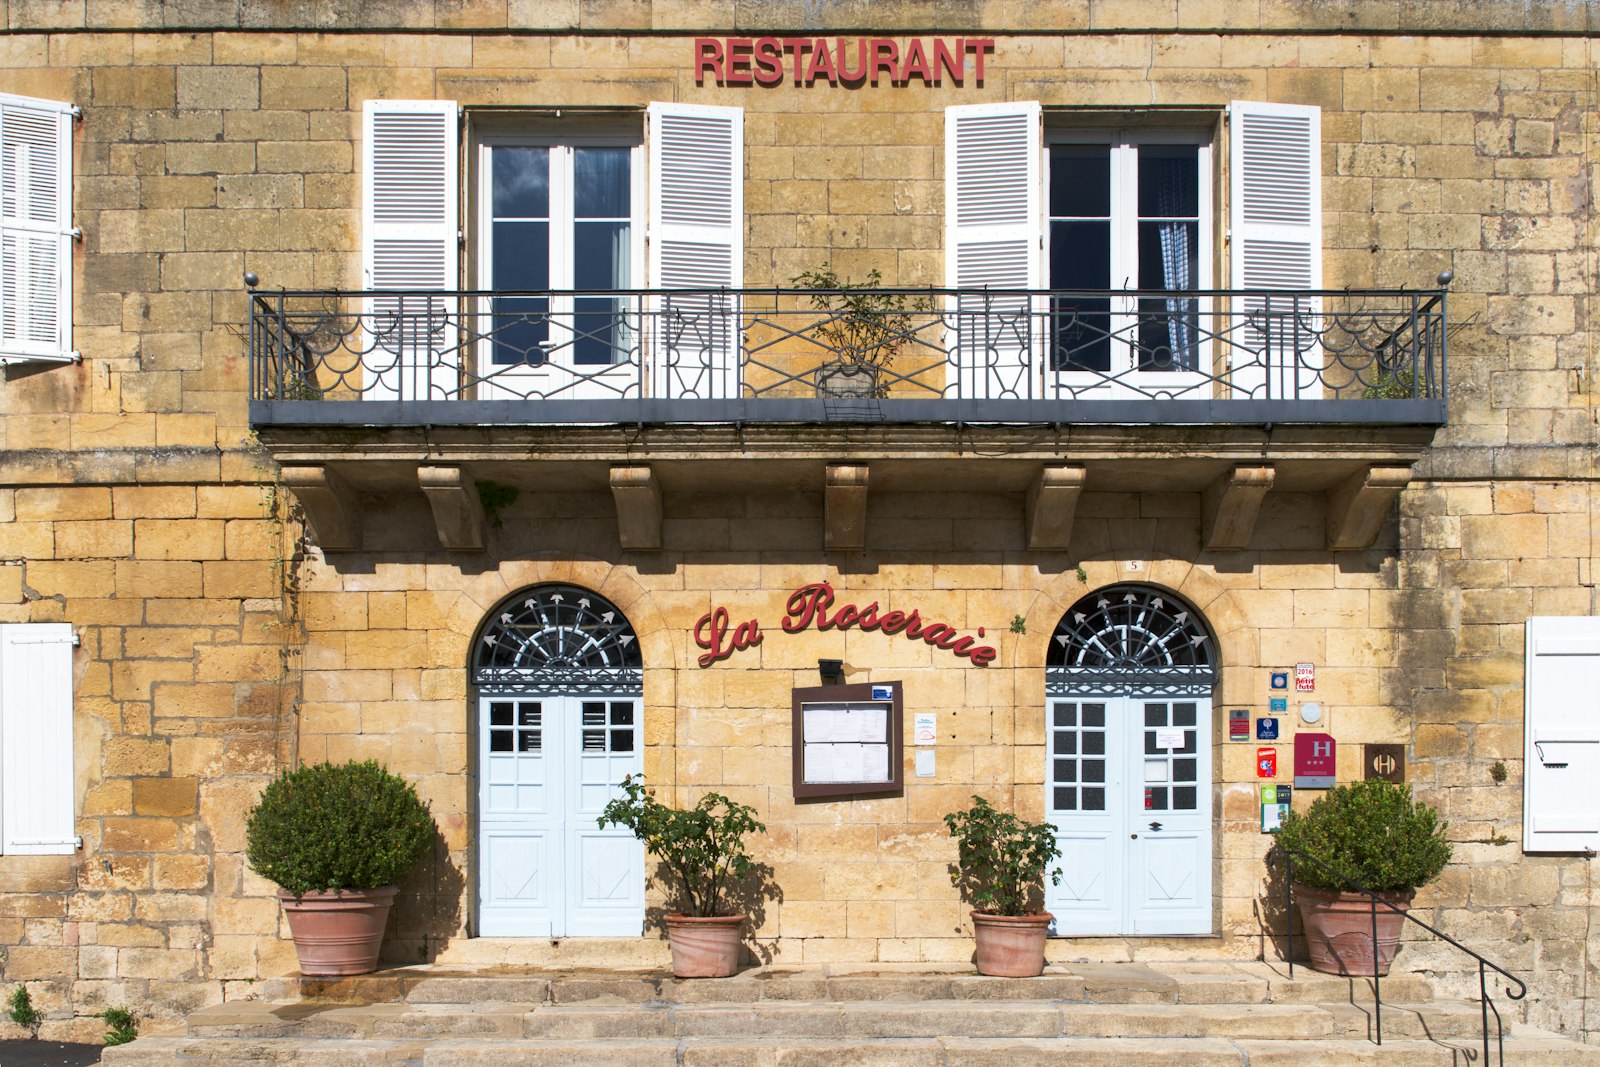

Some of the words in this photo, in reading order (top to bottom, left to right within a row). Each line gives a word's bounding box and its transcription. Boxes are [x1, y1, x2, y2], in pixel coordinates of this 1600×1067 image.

[694, 36, 995, 84] RESTAURANT
[1131, 560, 1138, 570] 5
[694, 606, 763, 667] La
[781, 581, 997, 666] Roseraie
[1313, 741, 1331, 757] H
